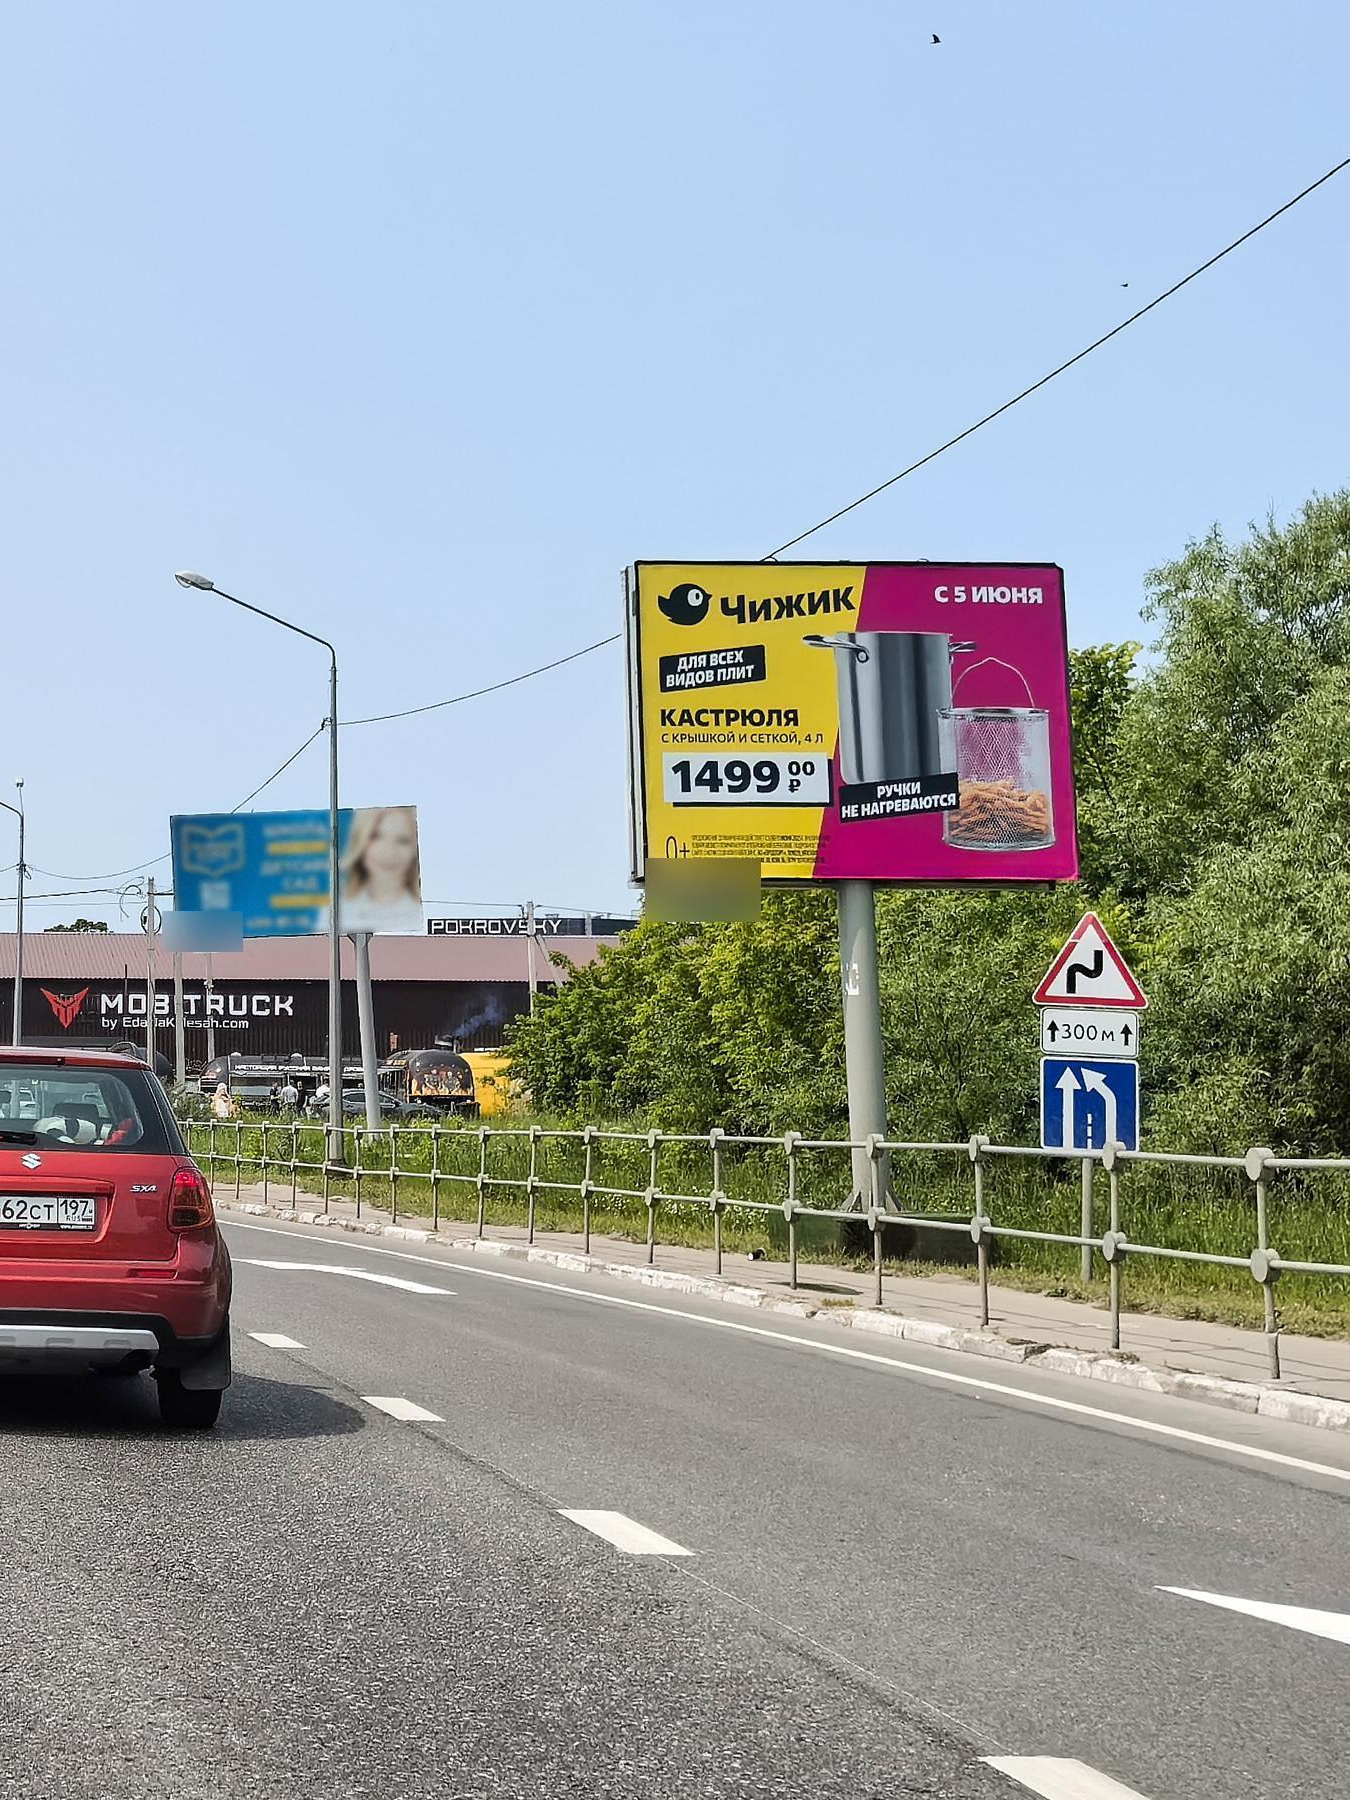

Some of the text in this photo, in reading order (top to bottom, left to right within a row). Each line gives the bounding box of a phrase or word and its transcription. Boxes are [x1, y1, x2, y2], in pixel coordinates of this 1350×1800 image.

[934, 586, 1043, 604] С 5 ИЮНЯ
[677, 650, 744, 672] ДЛЯ ВСЕХ
[666, 665, 755, 688] ВИДОВ ПЛИТ
[660, 708, 799, 727] КАСТРЮЛЯ
[661, 731, 824, 746] С КРЫШКОЙ И СЕТКОЙ, 4 Л
[671, 760, 815, 793] 1499 00
[877, 781, 921, 799] РУЧКИ
[841, 793, 956, 818] НЕ НАГРЕВАЮТСЯ
[431, 919, 562, 935] POKROVSKY
[101, 994, 294, 1016] MOBTRUCK
[102, 1016, 249, 1030] by EdaaKlesah.com
[1062, 1024, 1097, 1041] 300
[60, 1200, 89, 1216] 197
